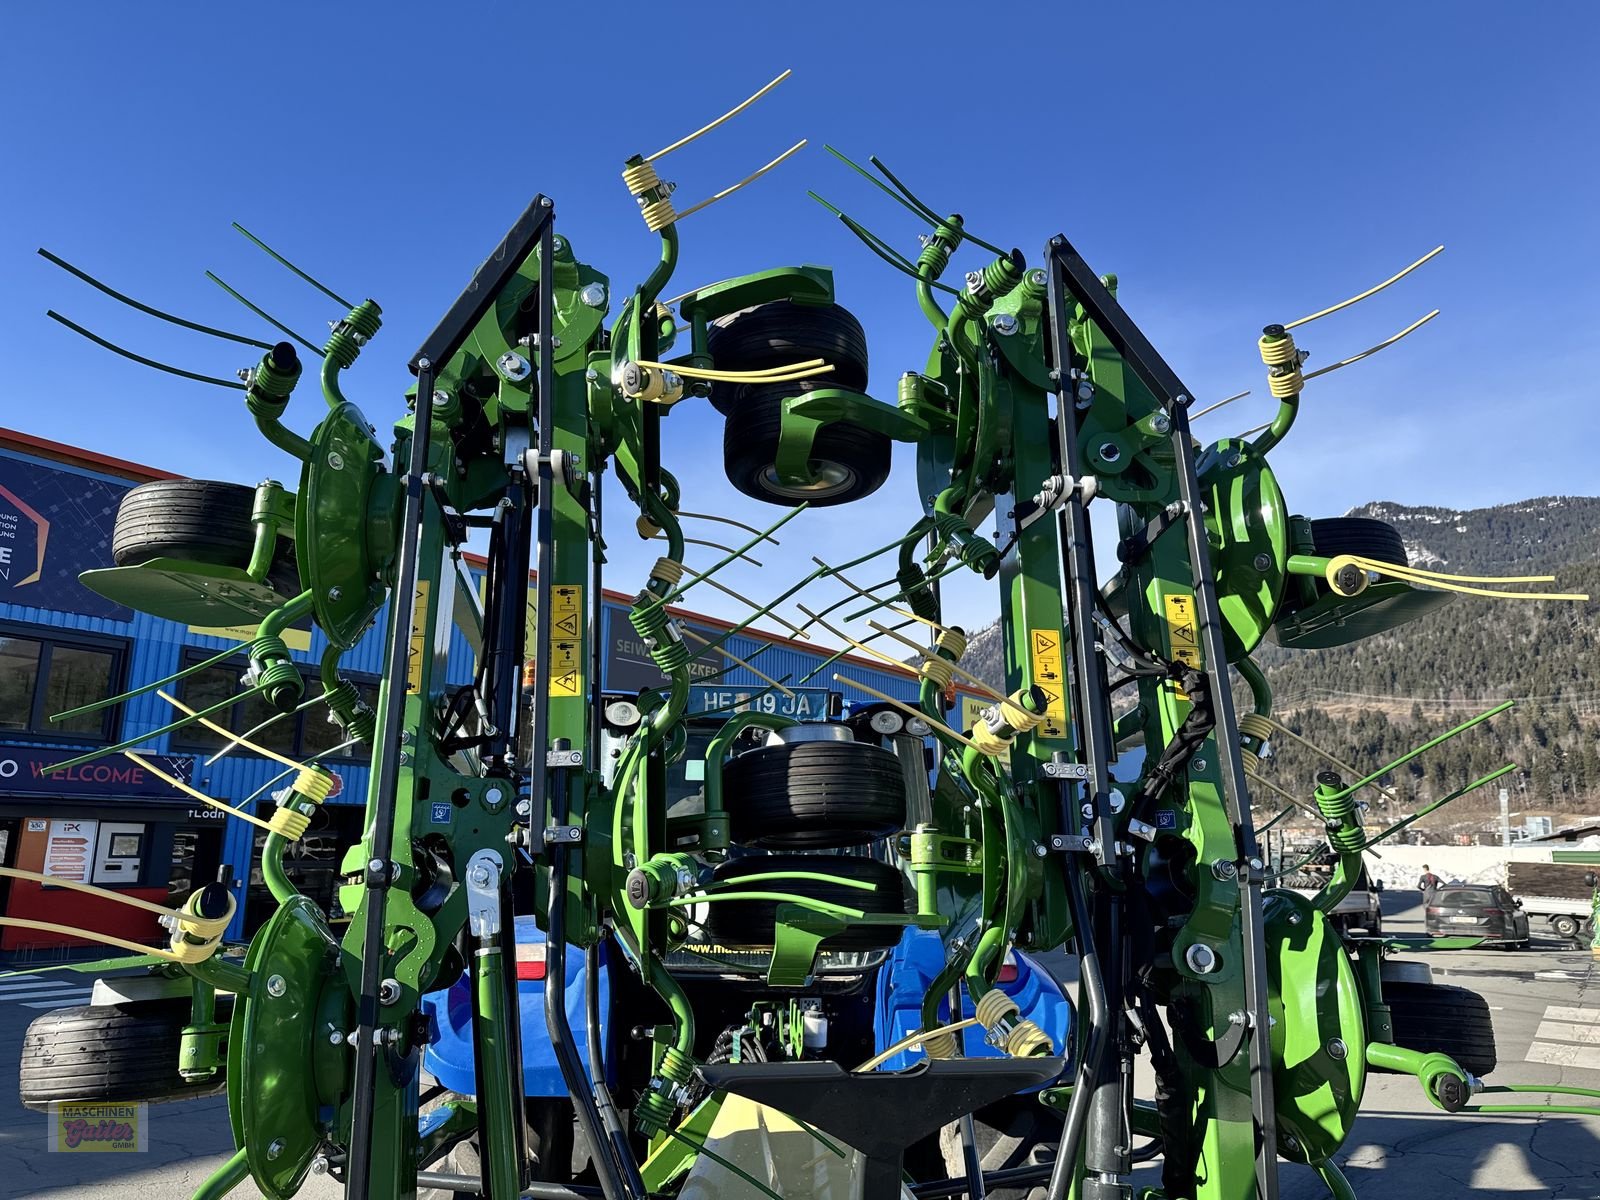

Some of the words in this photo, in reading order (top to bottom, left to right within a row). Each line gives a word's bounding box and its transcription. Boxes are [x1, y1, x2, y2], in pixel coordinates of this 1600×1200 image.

[616, 639, 648, 657] SEIW
[704, 691, 733, 713] HE
[30, 761, 145, 785] WELCOME
